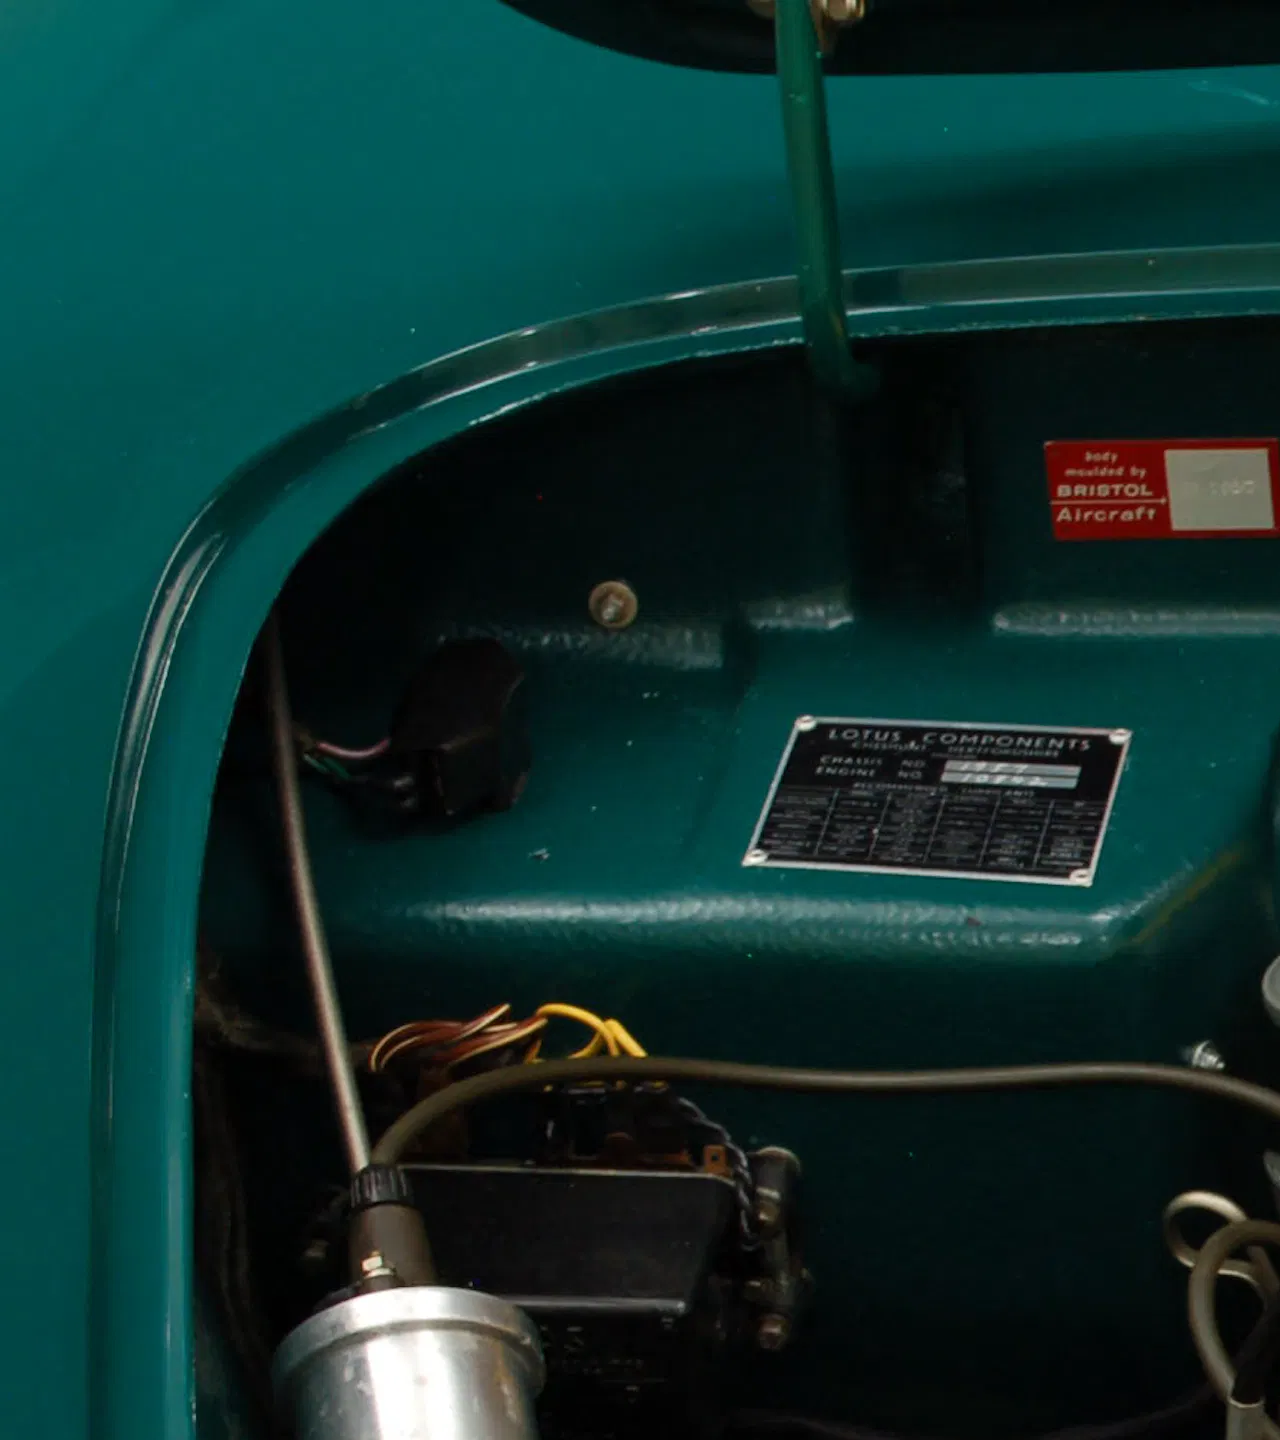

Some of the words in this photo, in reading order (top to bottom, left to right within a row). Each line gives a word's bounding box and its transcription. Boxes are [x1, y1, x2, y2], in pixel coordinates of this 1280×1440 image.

[1085, 451, 1118, 462] body
[1065, 466, 1124, 477] moulded
[1130, 465, 1147, 479] by
[1056, 484, 1153, 497] BRISTOL
[1056, 506, 1157, 522] Aircraft
[828, 728, 901, 742] LOTUS
[922, 732, 1090, 751] COMPONENTS
[819, 754, 883, 766] CHASSIS
[814, 765, 877, 777] ENGINE
